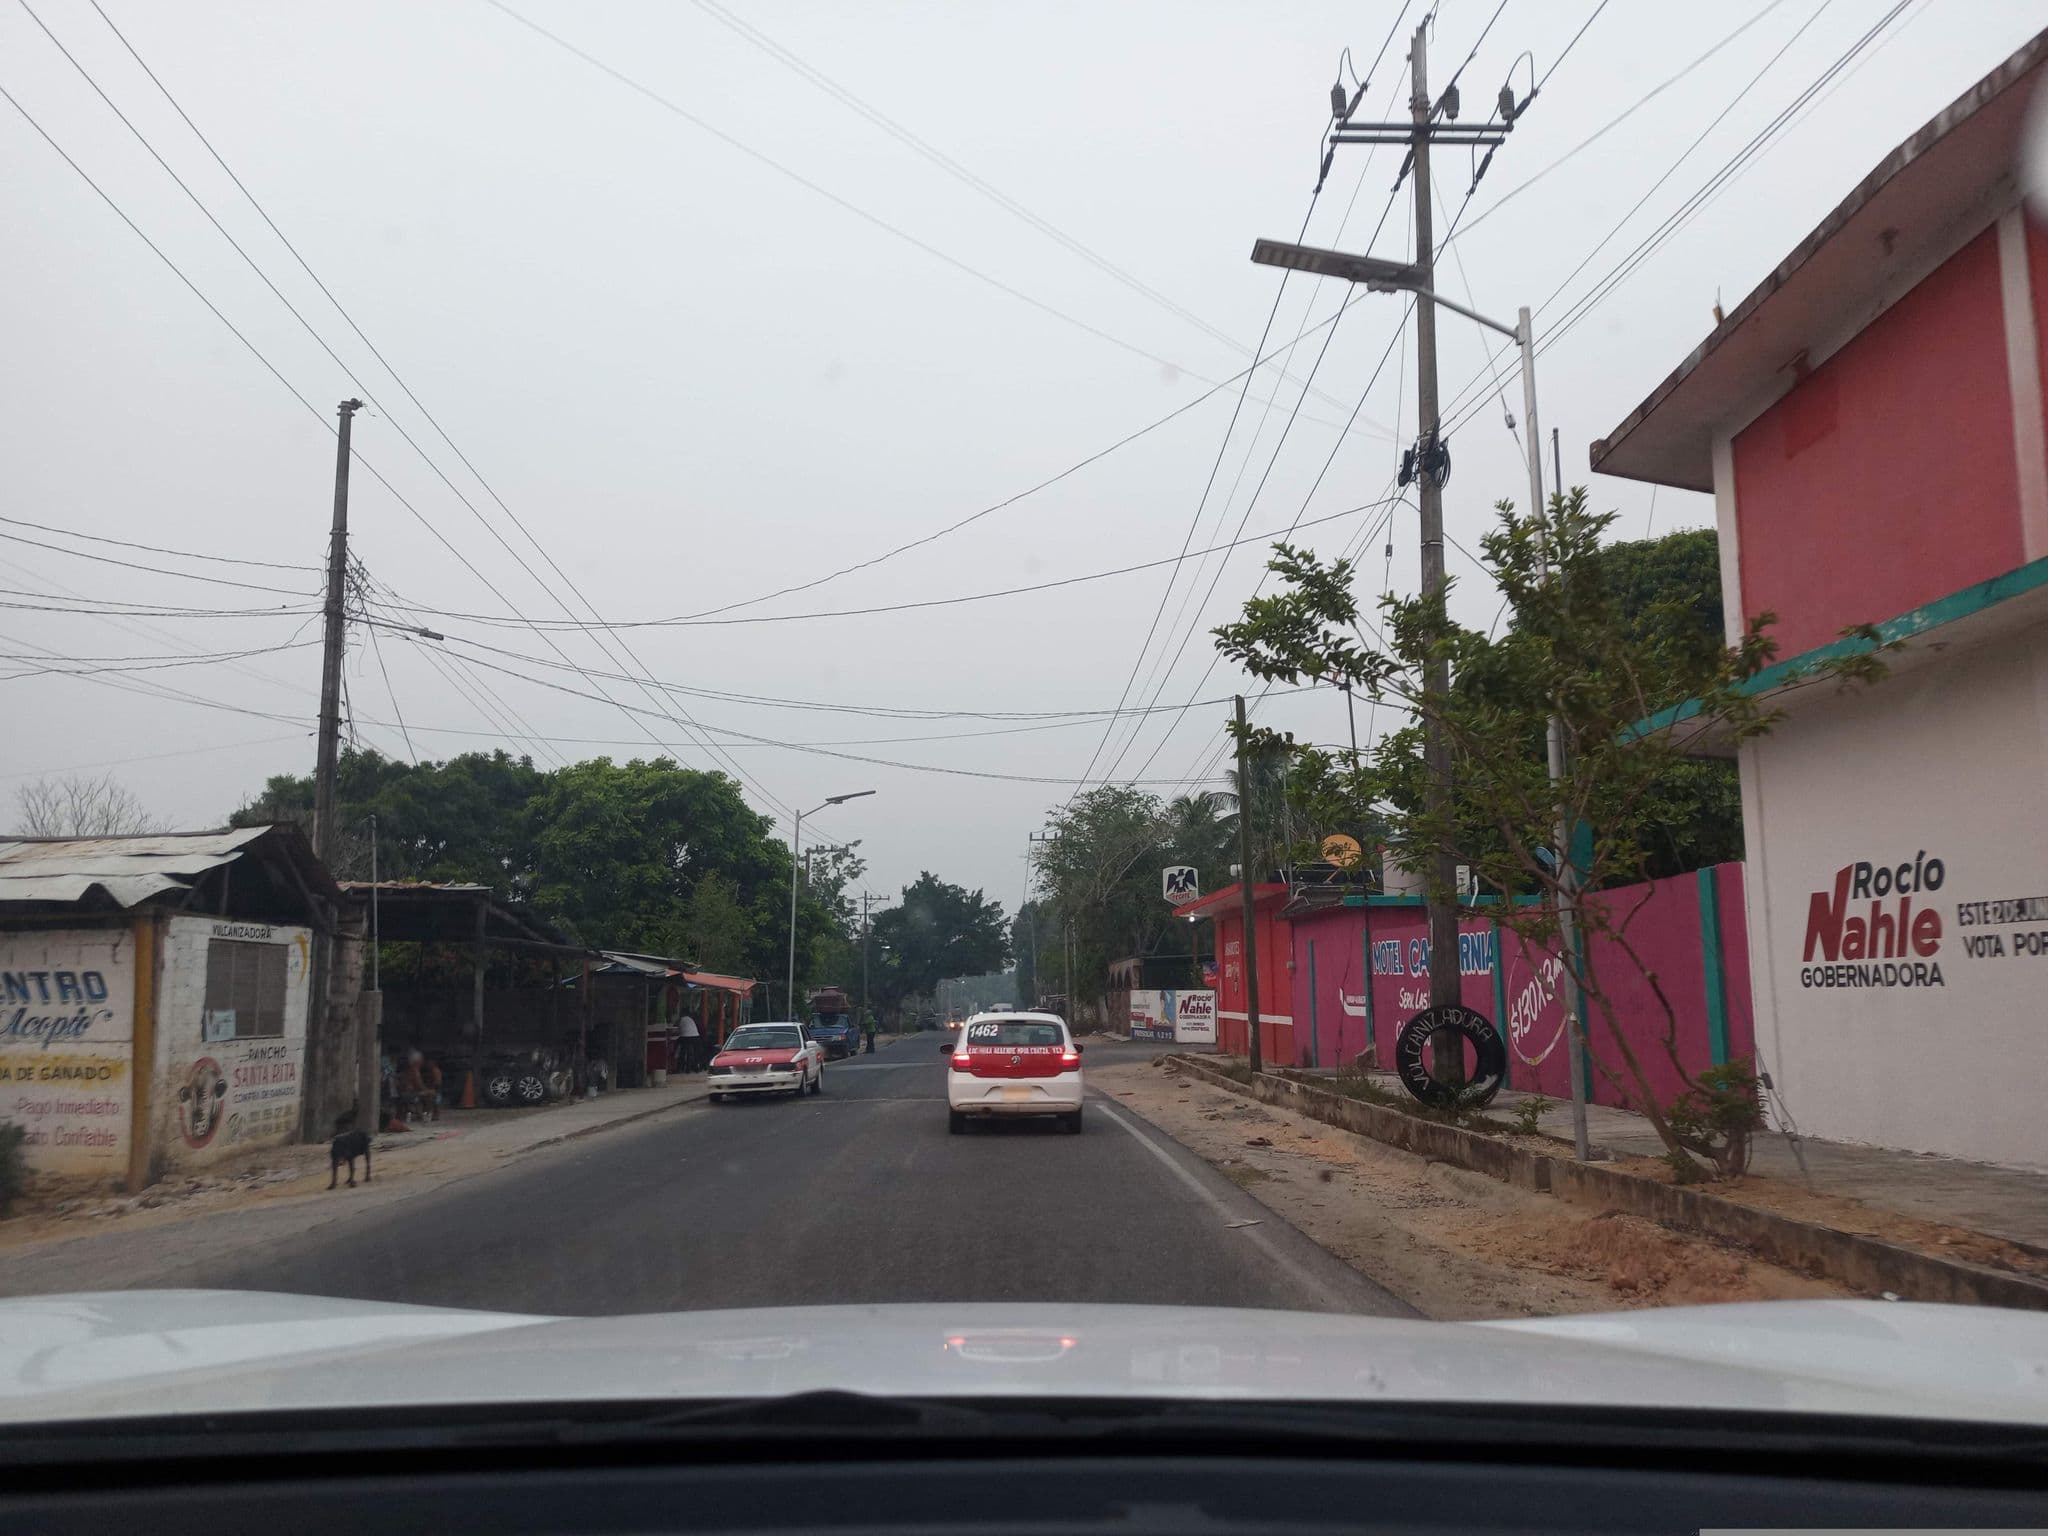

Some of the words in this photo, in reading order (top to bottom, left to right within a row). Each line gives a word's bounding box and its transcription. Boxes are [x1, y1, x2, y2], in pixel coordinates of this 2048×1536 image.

[1852, 850, 1945, 899] Rocío
[1803, 864, 1943, 962] Nahle
[1373, 939, 1404, 975] MOTEL
[1962, 934, 2006, 958] VOTA
[1801, 962, 1945, 988] GOBERNADORA
[1179, 995, 1213, 1014] Nahle
[969, 1024, 999, 1038] 1462
[16, 1067, 34, 1081] DE
